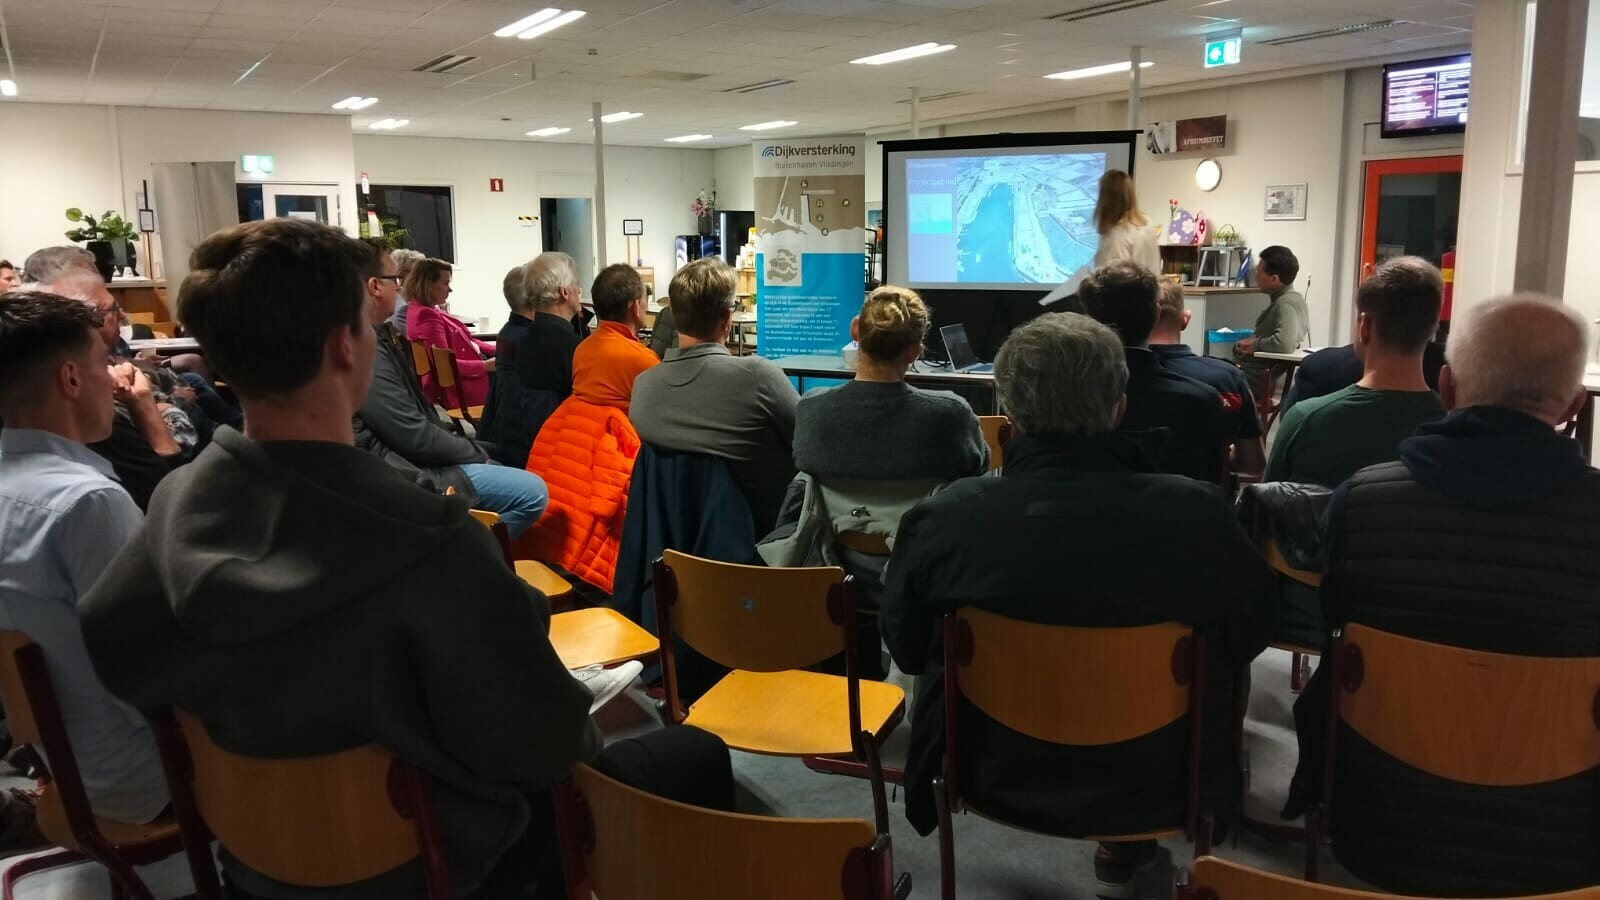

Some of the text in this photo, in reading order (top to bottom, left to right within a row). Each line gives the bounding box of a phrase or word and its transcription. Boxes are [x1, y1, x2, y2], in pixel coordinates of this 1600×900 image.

[775, 143, 856, 159] Dijkversterking
[775, 160, 854, 169] Buitenhaven Vlissingen
